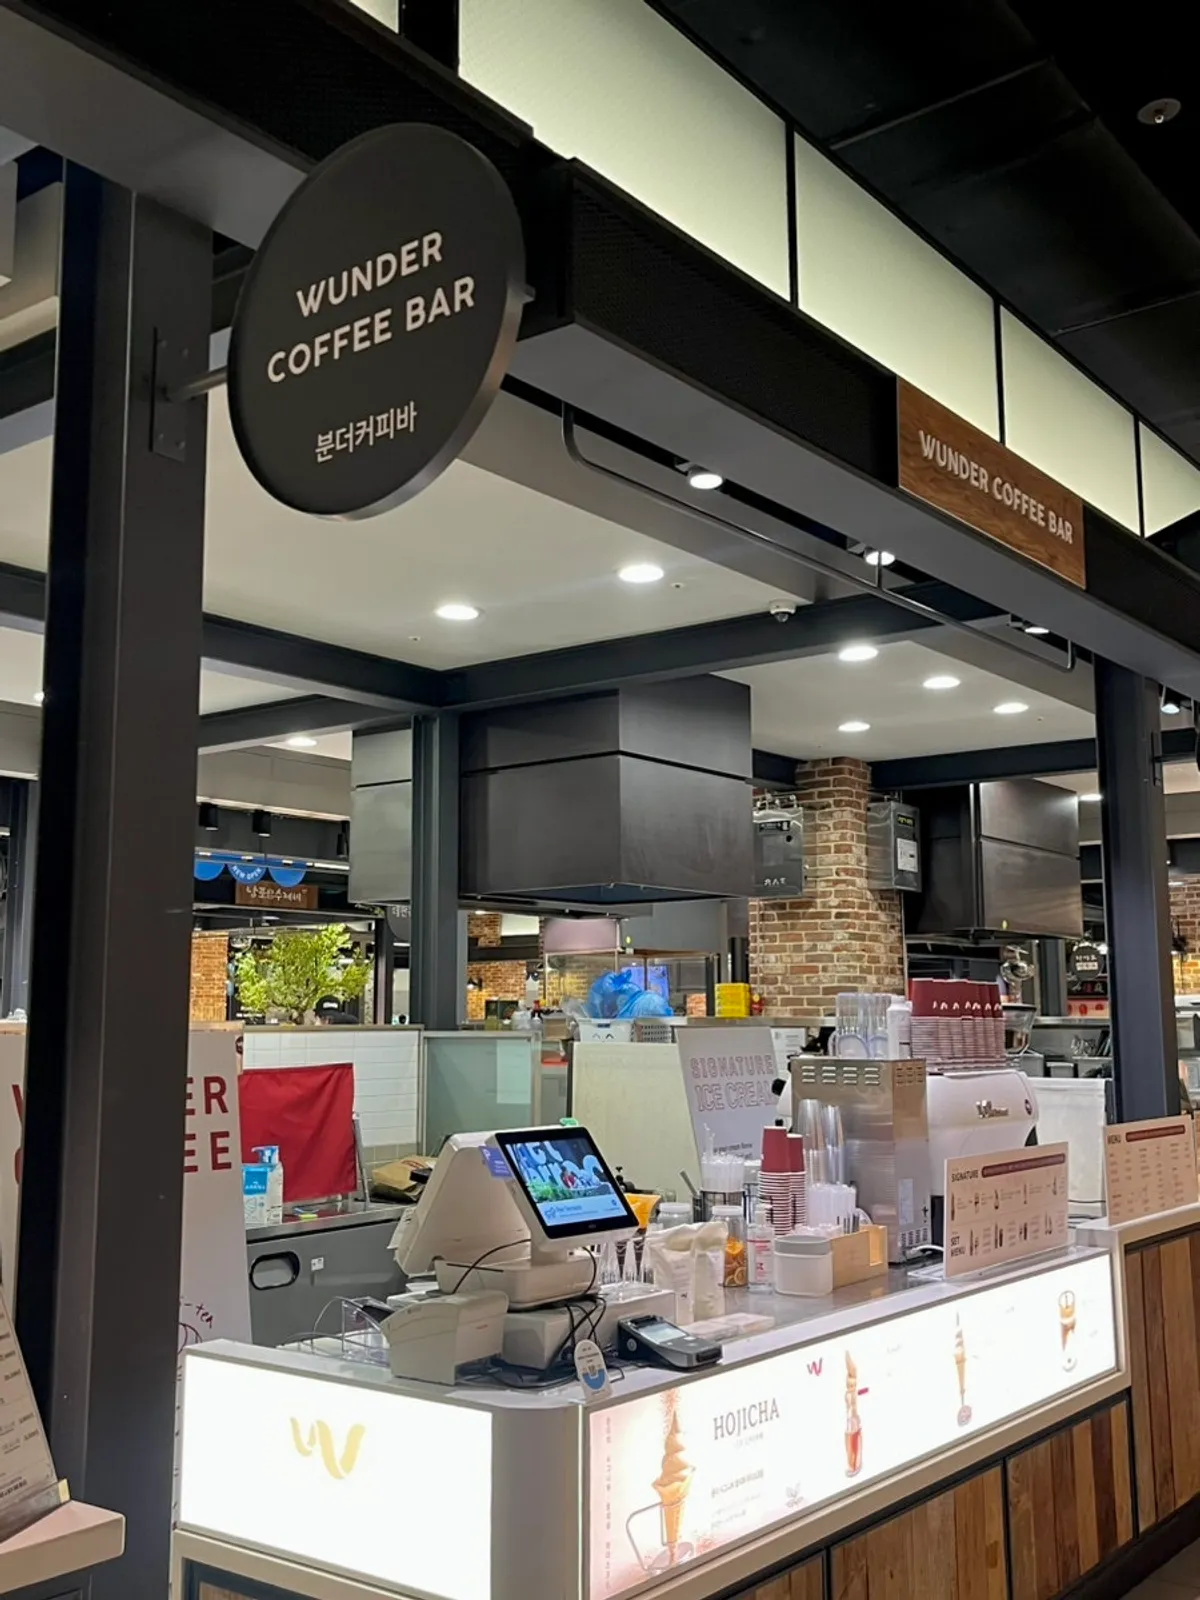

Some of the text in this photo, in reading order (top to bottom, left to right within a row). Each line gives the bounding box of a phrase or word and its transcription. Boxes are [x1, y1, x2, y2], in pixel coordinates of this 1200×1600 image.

[297, 232, 443, 318] WUNDER
[267, 276, 475, 383] COFFEE BAR
[315, 401, 418, 463] 분더커피바
[919, 430, 1073, 545] WUNDER COFFEE BAR
[690, 1055, 774, 1079] SIGNATURE
[695, 1083, 725, 1112] ICE
[951, 1169, 979, 1183] SIGNATURE
[713, 1398, 780, 1440] HOJICHA
